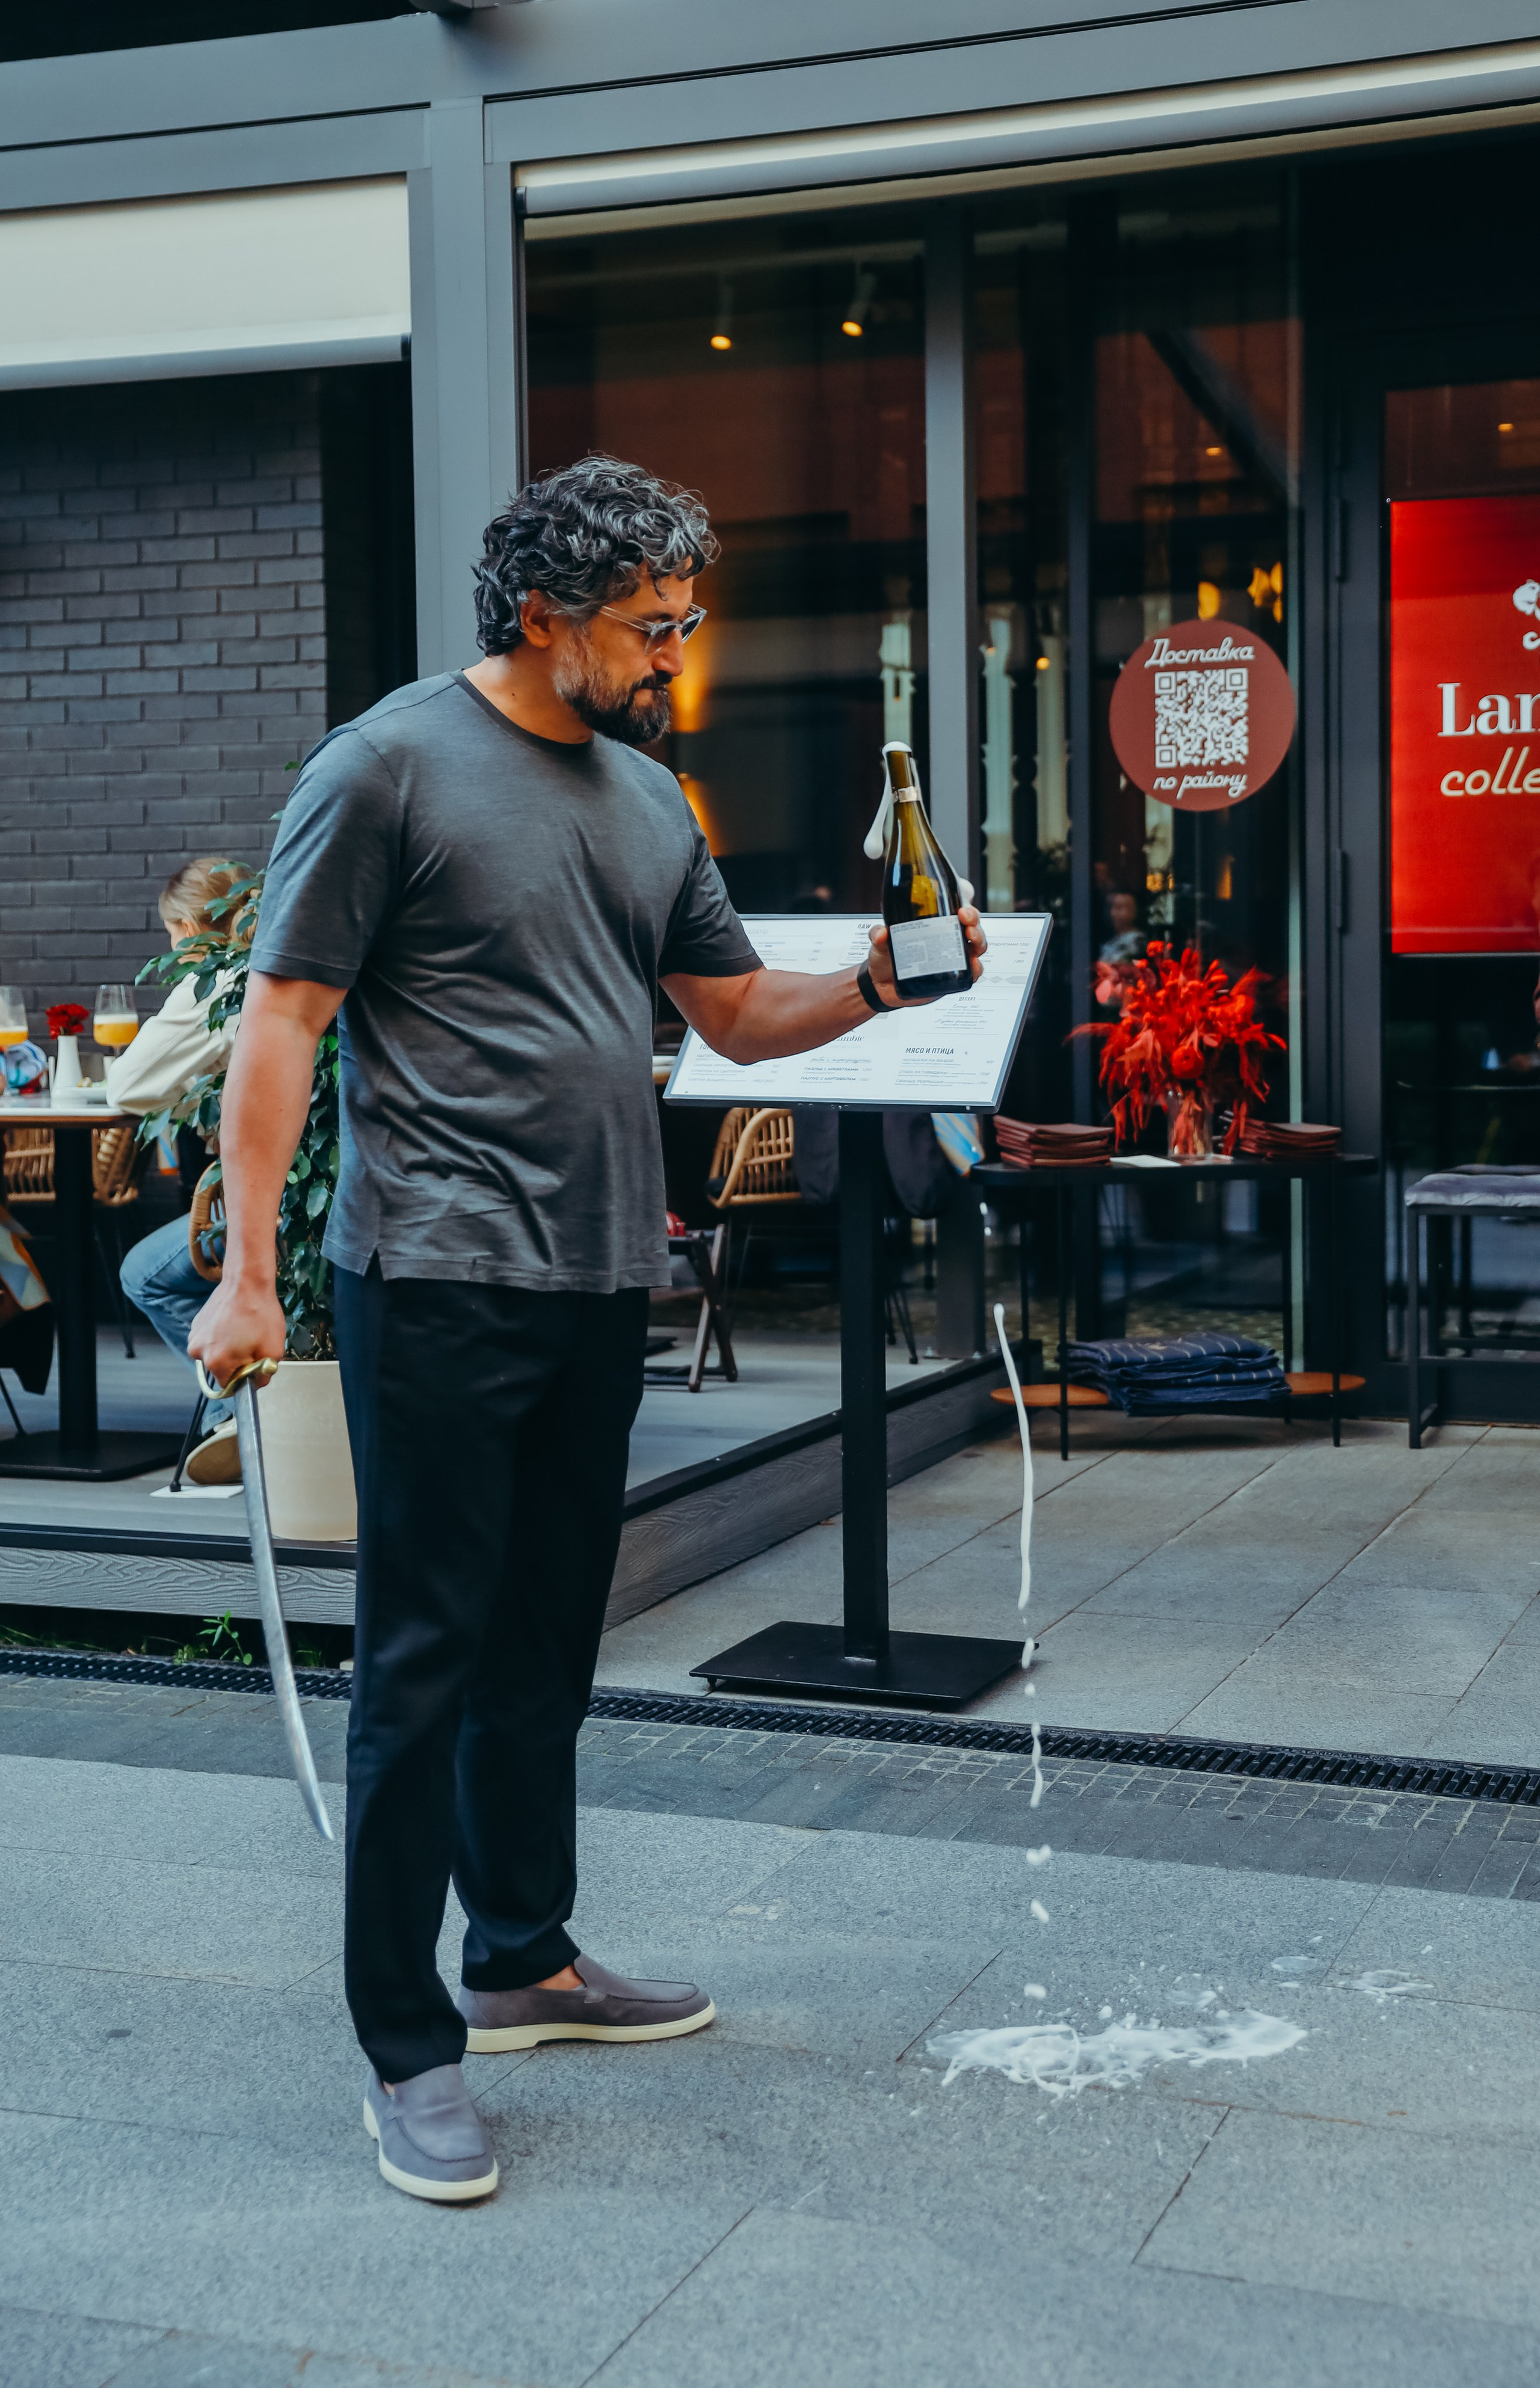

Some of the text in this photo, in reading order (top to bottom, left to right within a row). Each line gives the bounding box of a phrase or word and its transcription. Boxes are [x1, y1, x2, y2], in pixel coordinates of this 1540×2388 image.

[1144, 636, 1255, 668] Доставка
[1153, 771, 1248, 799] по району
